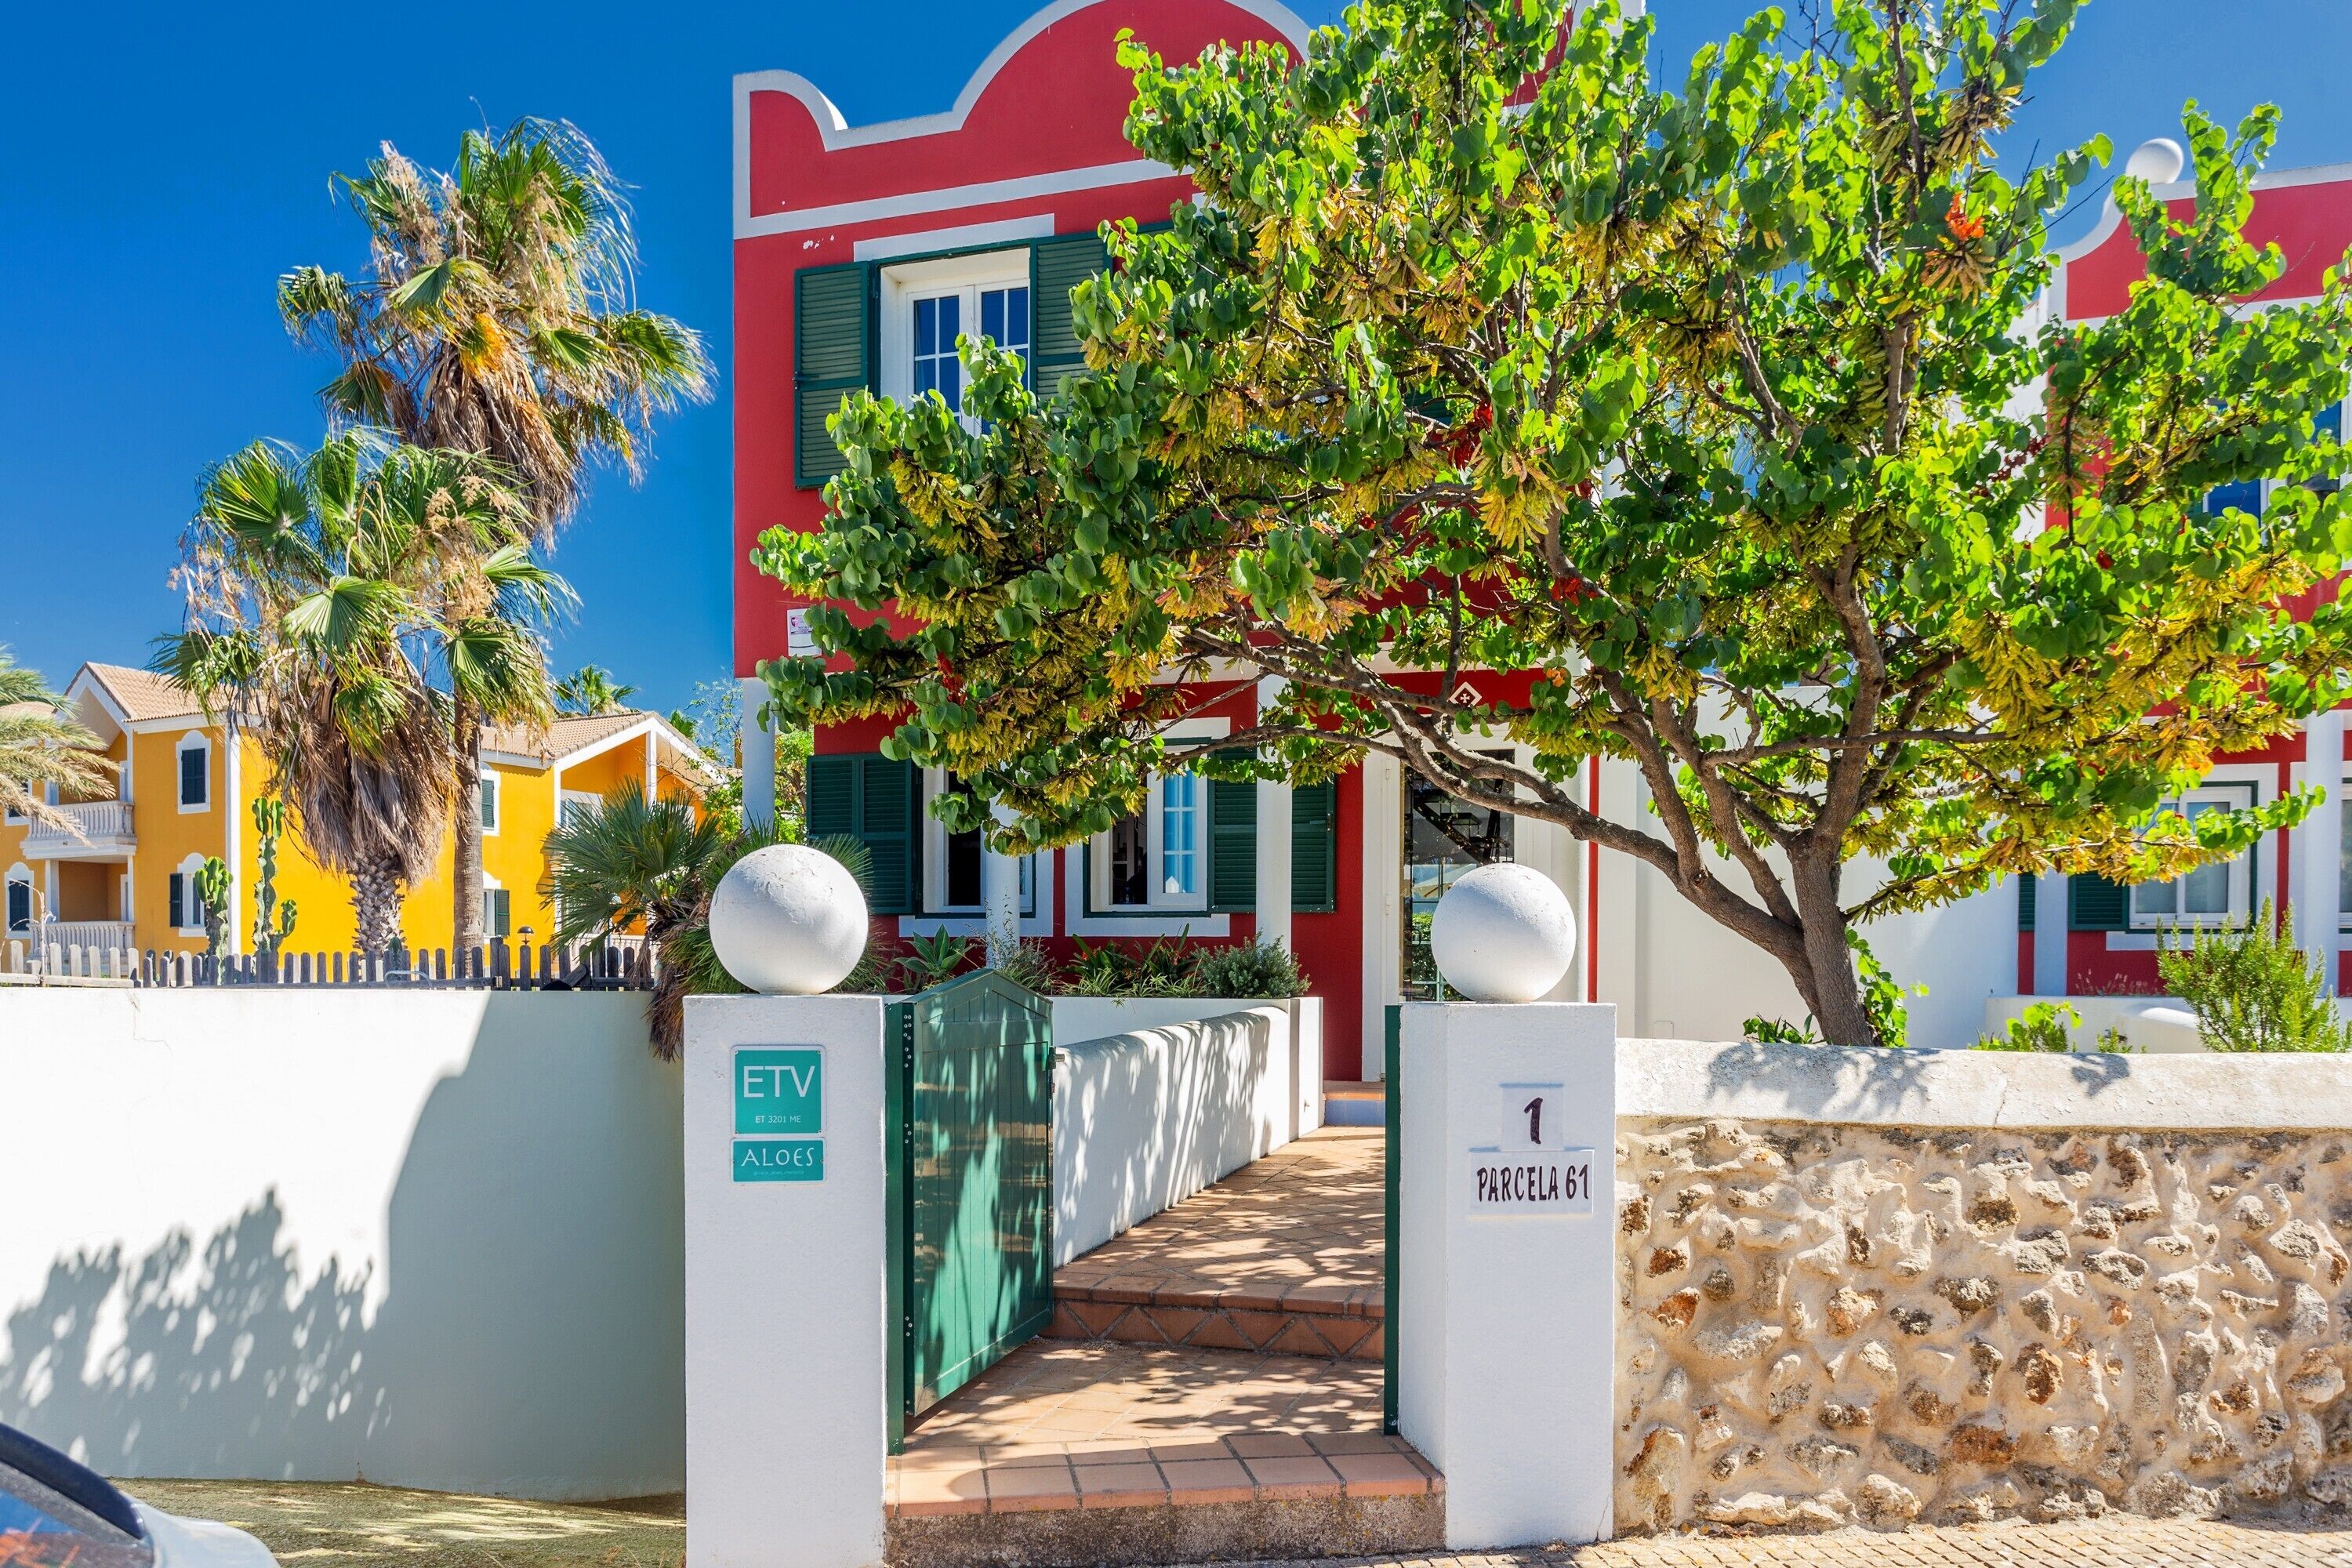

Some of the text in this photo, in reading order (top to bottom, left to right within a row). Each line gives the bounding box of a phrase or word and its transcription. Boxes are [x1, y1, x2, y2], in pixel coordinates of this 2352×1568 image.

[744, 1065, 815, 1098] ETV
[755, 1115, 765, 1123] ET
[768, 1115, 786, 1123] 3201
[1523, 1097, 1543, 1144] 1
[741, 1148, 815, 1167] ALOES
[1476, 1164, 1589, 1202] PARCELA 61
